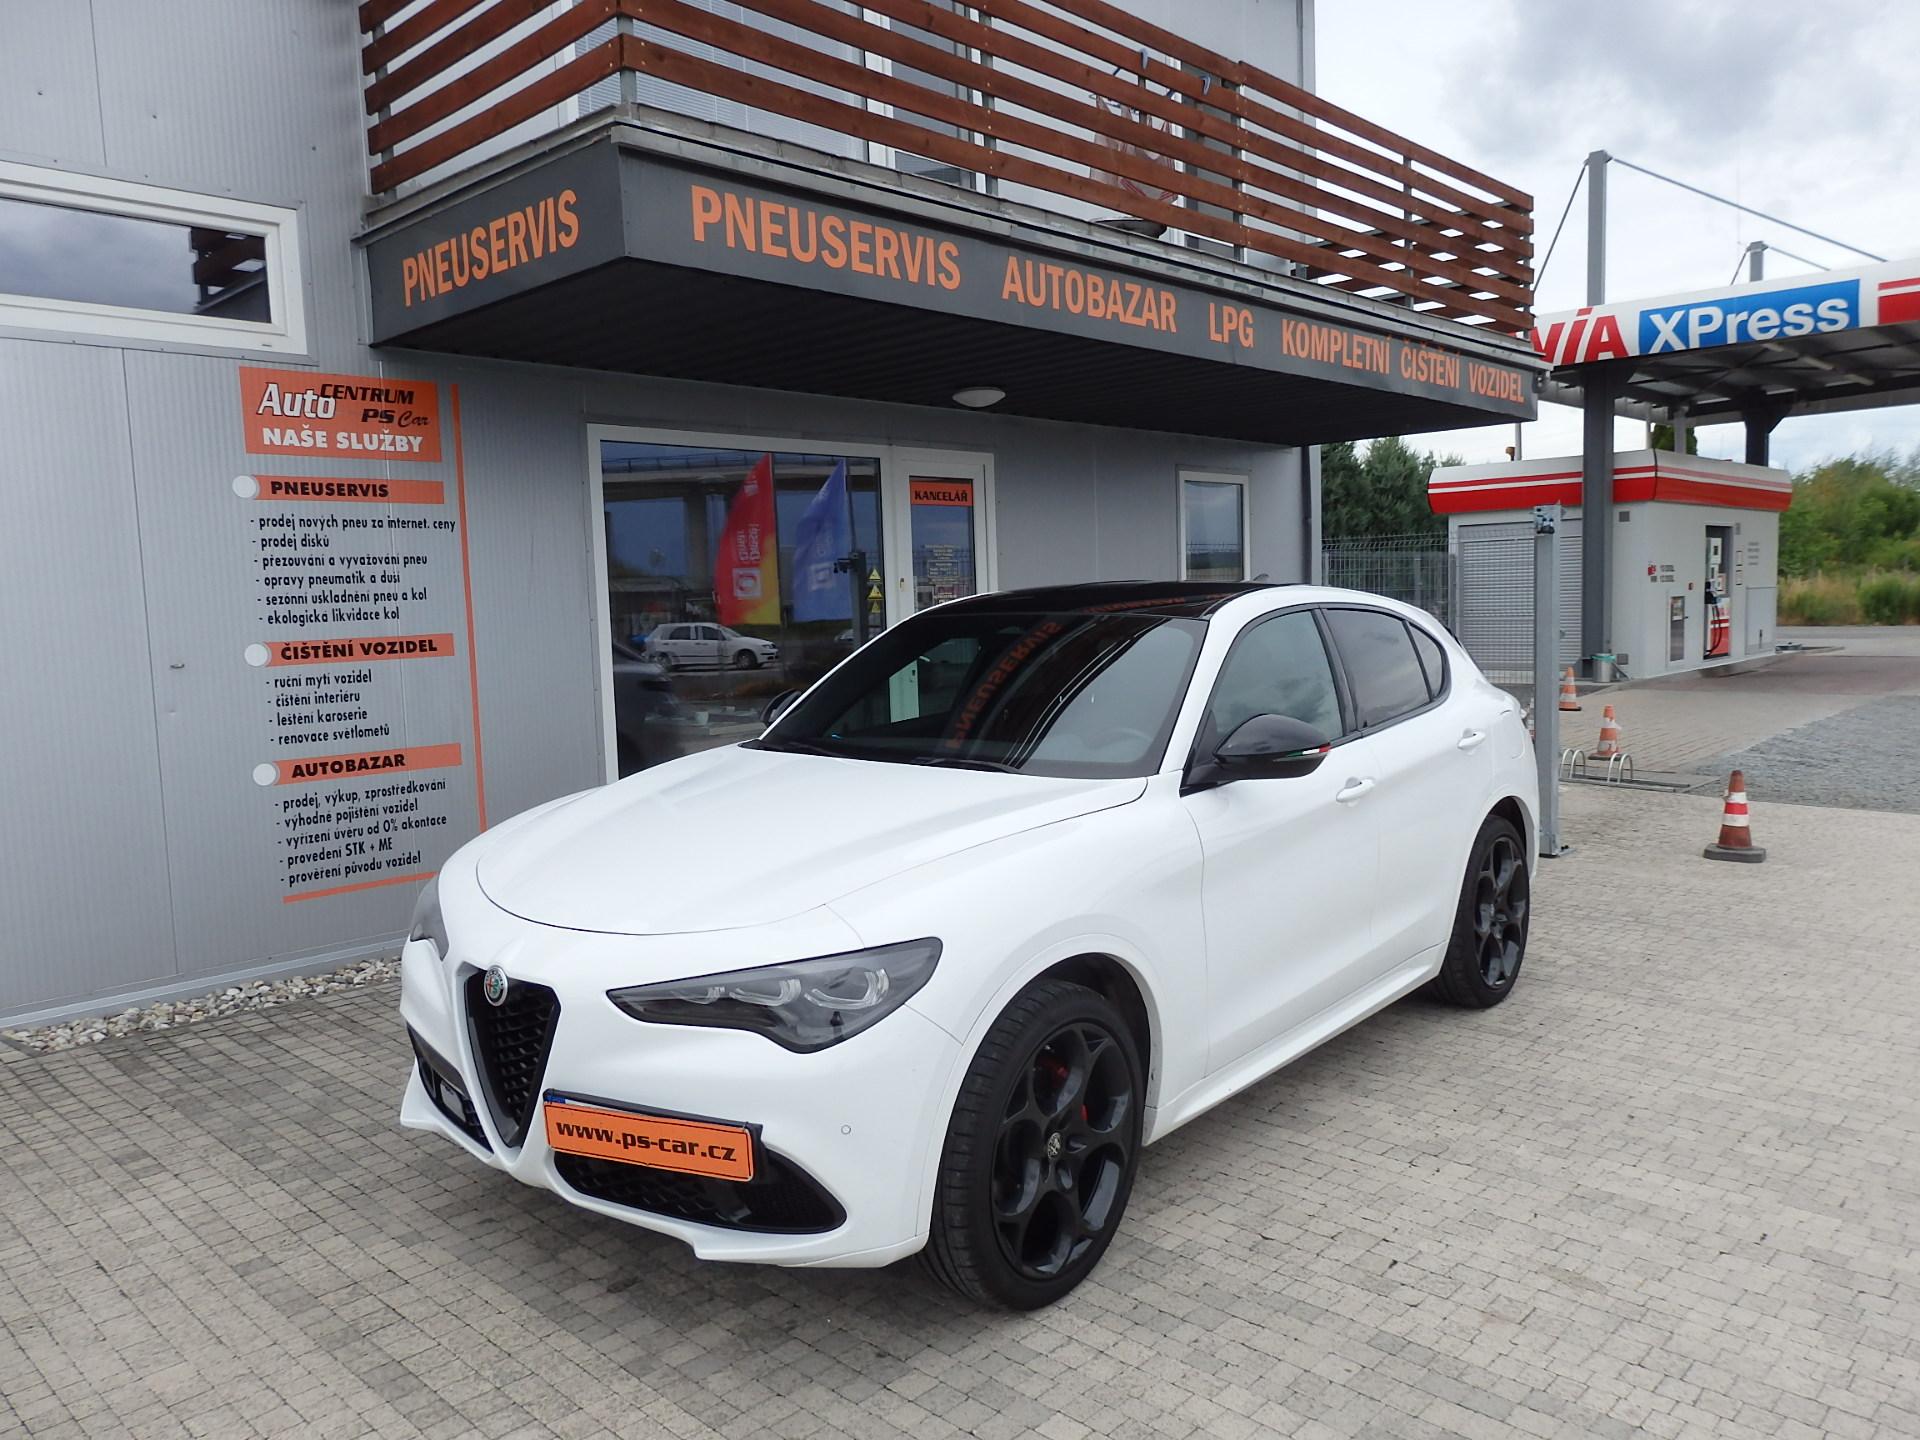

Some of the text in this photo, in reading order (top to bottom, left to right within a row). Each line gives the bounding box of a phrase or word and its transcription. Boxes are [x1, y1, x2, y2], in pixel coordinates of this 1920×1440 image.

[402, 189, 579, 307] PNEUSERVIS
[690, 184, 1525, 403] PNEUSERVIS AUTOBAZAR LPG KOMPLETNÍ ČIŠTĚNÍ VOZIDEL
[1647, 298, 1850, 355] XPress
[256, 382, 415, 419] Auto CENTRUM
[361, 408, 431, 428] PS Car
[262, 423, 424, 453] NAŠE SLUŽBY
[270, 480, 390, 498] PNEUSERVIS
[259, 513, 456, 532] prodej nových pneu za internet. ceny
[261, 533, 297, 551] prodej
[262, 553, 428, 570] přezouvání a vyvažování pneu
[264, 576, 304, 589] opravy
[308, 570, 366, 589] pneumatik
[370, 574, 376, 584] a
[266, 587, 427, 605] sezónní uskladnění pneu a kol
[268, 606, 399, 627] ekologická likvidace kol
[281, 639, 437, 660] ČIŠTĚNÍ VOZIDEL
[274, 674, 302, 688] ruční
[334, 668, 372, 684] vozidel
[276, 689, 360, 708] čištění interiéru
[277, 706, 368, 727] leštění karoserie
[278, 723, 390, 745] renovace světlometů
[291, 753, 406, 778] AUTOBAZAR
[283, 778, 446, 813] prodej, výkup, zprostředkování
[336, 804, 379, 825] pojištění
[382, 797, 418, 815] vozidel
[286, 816, 447, 849] vyřízení úvěru od 0% akontace
[288, 837, 393, 869] provedení STK + ME
[289, 850, 421, 888] prověření původu vozidel
[556, 1121, 737, 1162] www.ps-car.cz
